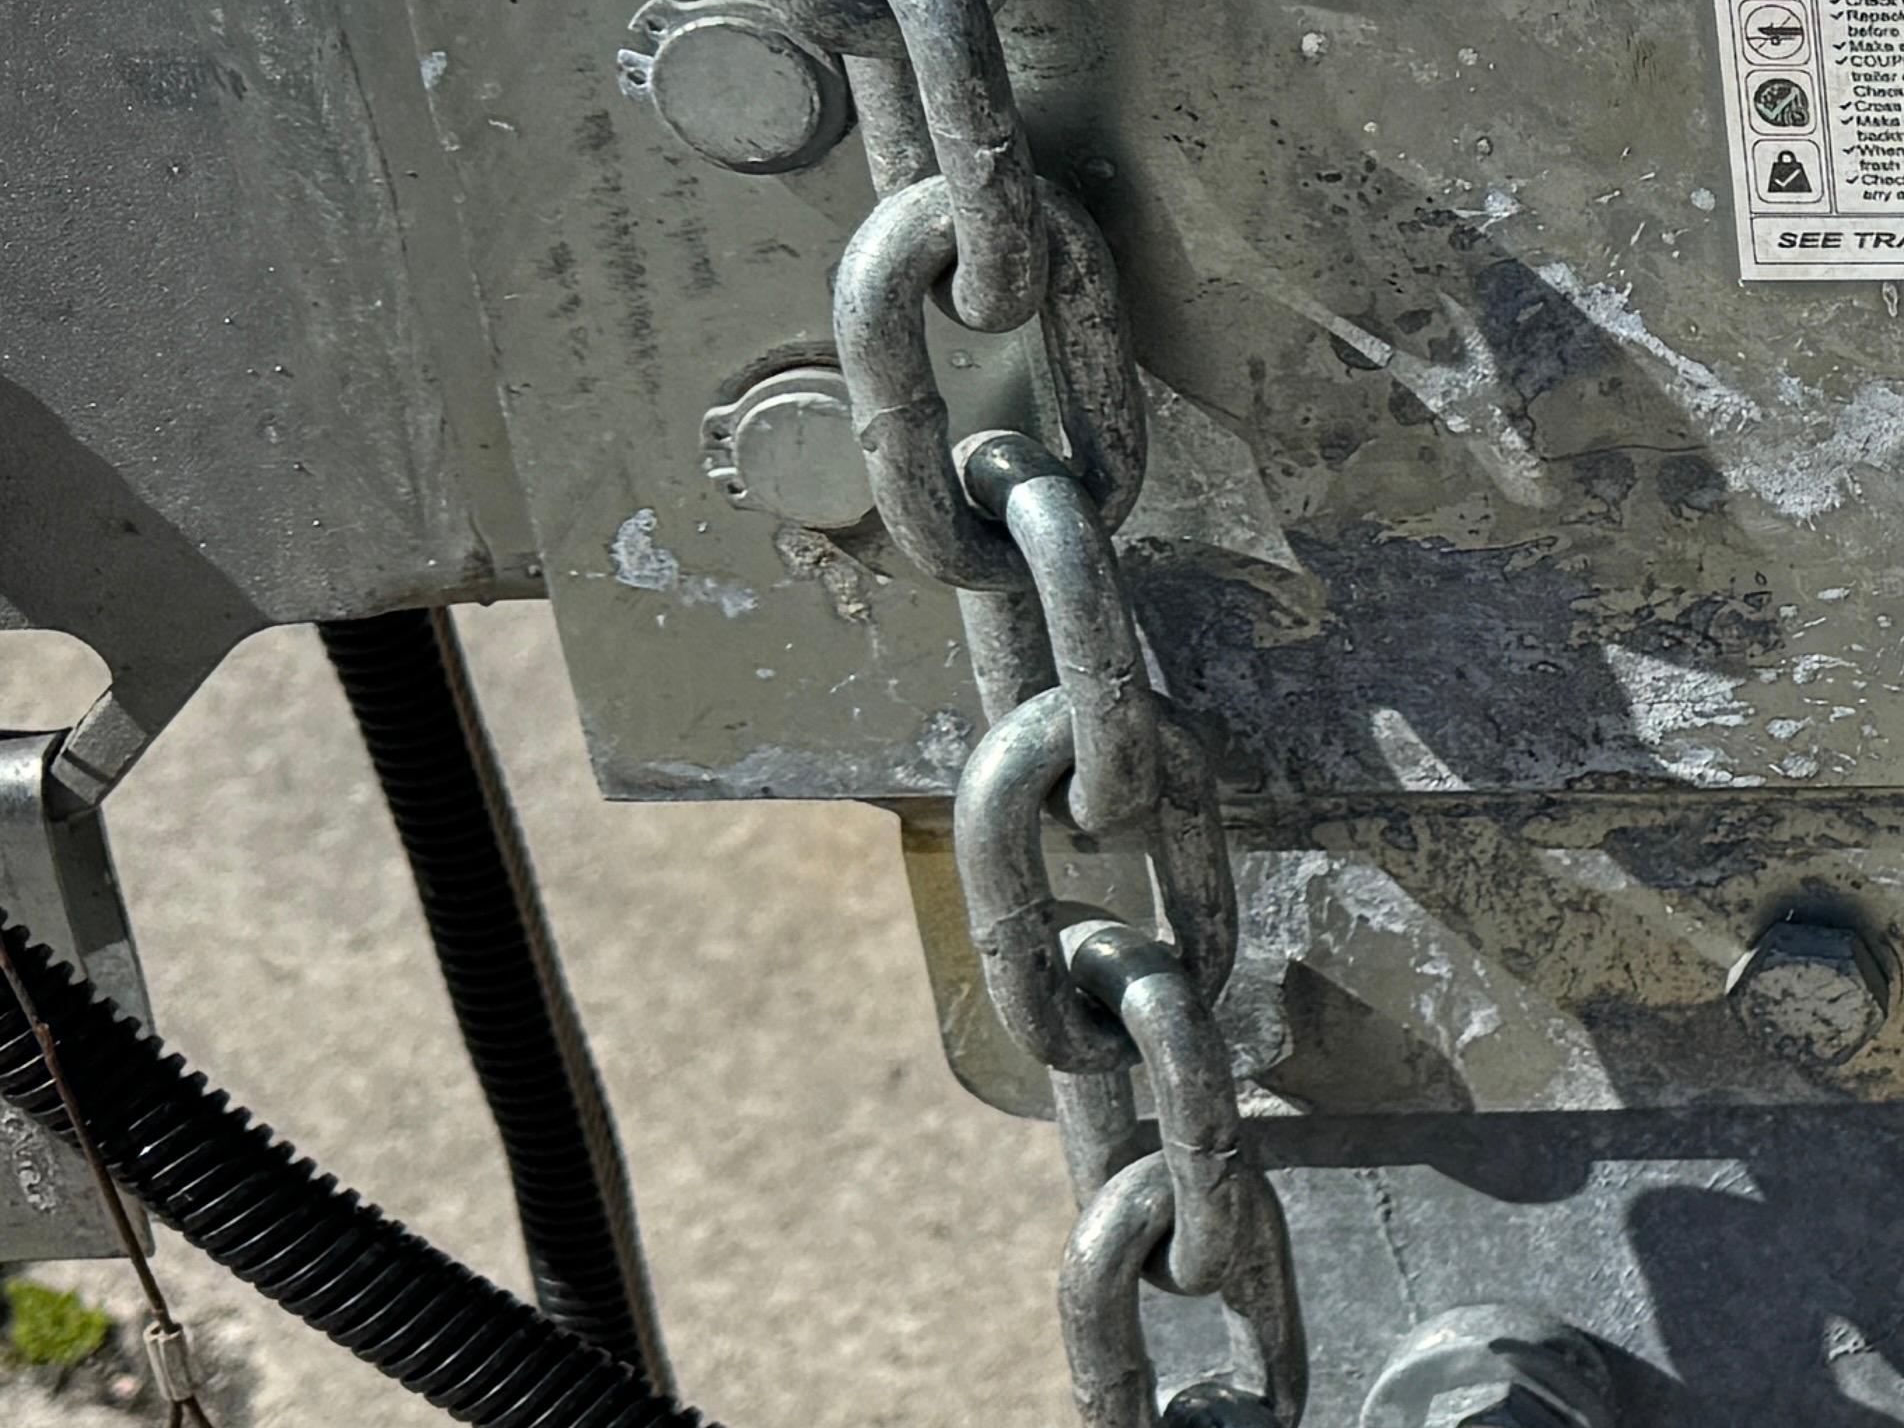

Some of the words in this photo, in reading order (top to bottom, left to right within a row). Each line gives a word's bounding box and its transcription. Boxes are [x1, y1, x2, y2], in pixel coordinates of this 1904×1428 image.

[1848, 25, 1900, 37] before
[1850, 40, 1894, 52] Make
[1851, 71, 1898, 82] trailer
[1853, 85, 1904, 98] Check
[1854, 100, 1902, 113] Cross
[1856, 115, 1901, 128] Make
[1859, 159, 1901, 172] fresh
[1863, 189, 1892, 202] any
[1778, 232, 1844, 249] SEE
